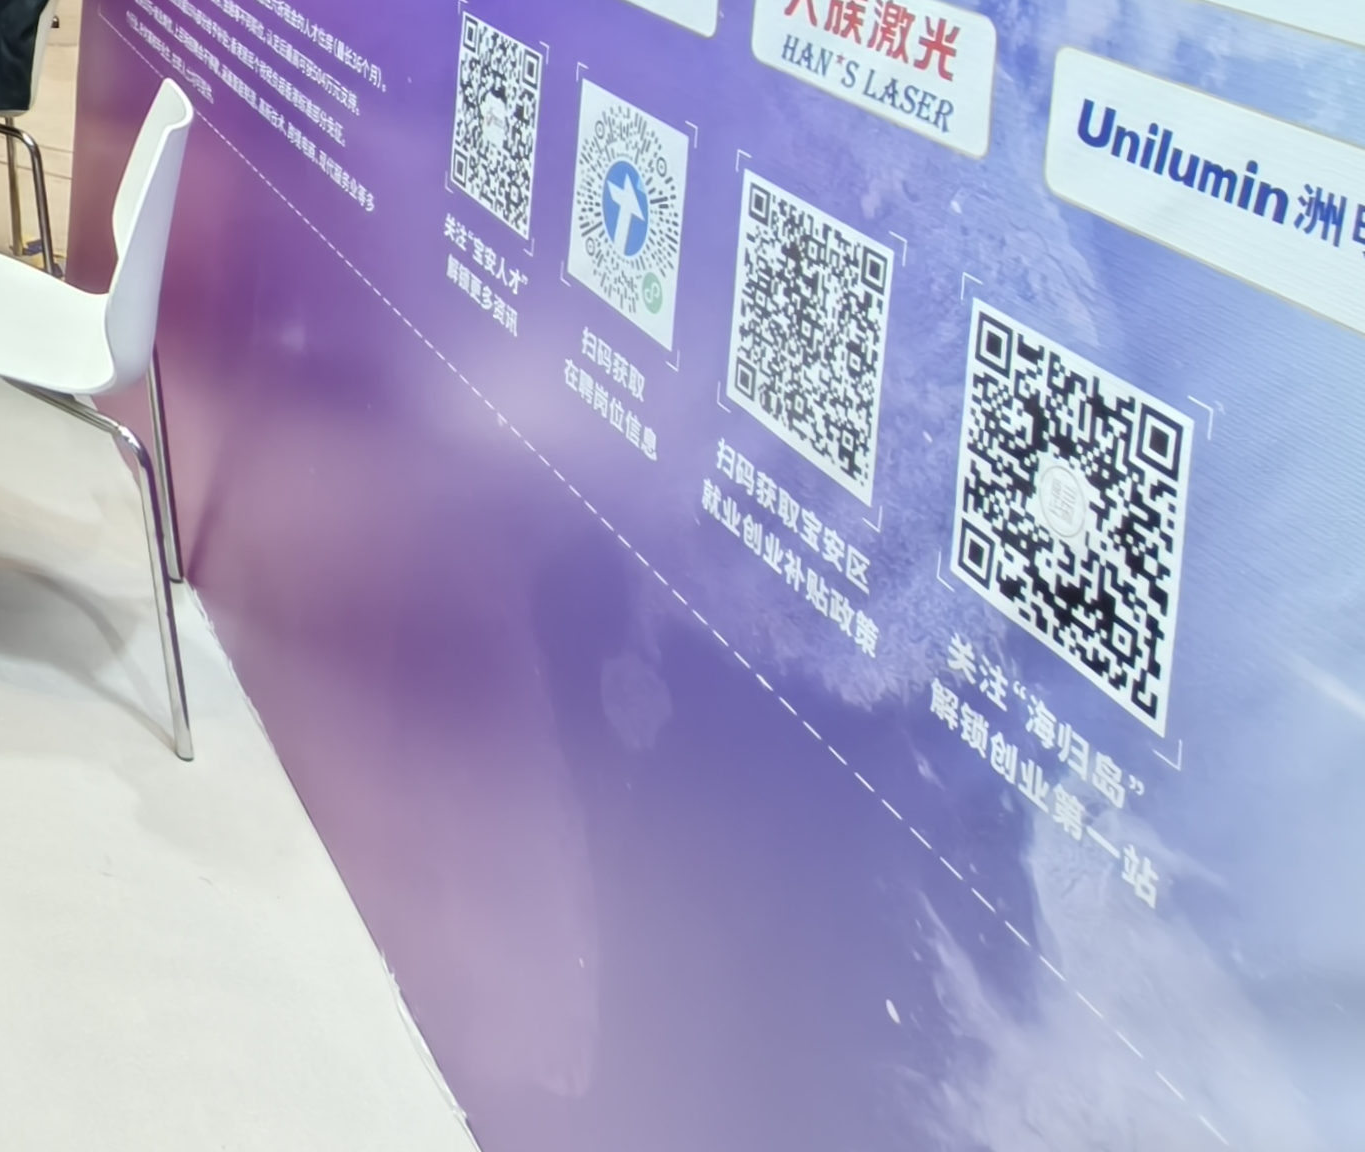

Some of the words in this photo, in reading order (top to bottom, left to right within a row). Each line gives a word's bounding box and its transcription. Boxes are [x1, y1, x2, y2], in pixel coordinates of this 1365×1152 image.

[862, 66, 955, 134] LASER
[1076, 98, 1290, 227] Unilumin
[446, 252, 519, 337] 解锁更多资讯
[563, 357, 658, 462] 在聘岗位信息
[581, 326, 646, 404] 扫码获取
[701, 478, 879, 659] 就业创业补贴政策
[716, 438, 871, 595] 扫码获取宝安区
[947, 631, 1145, 810] 关注“海归岛”
[929, 676, 1159, 910] 解锁创业第一站
